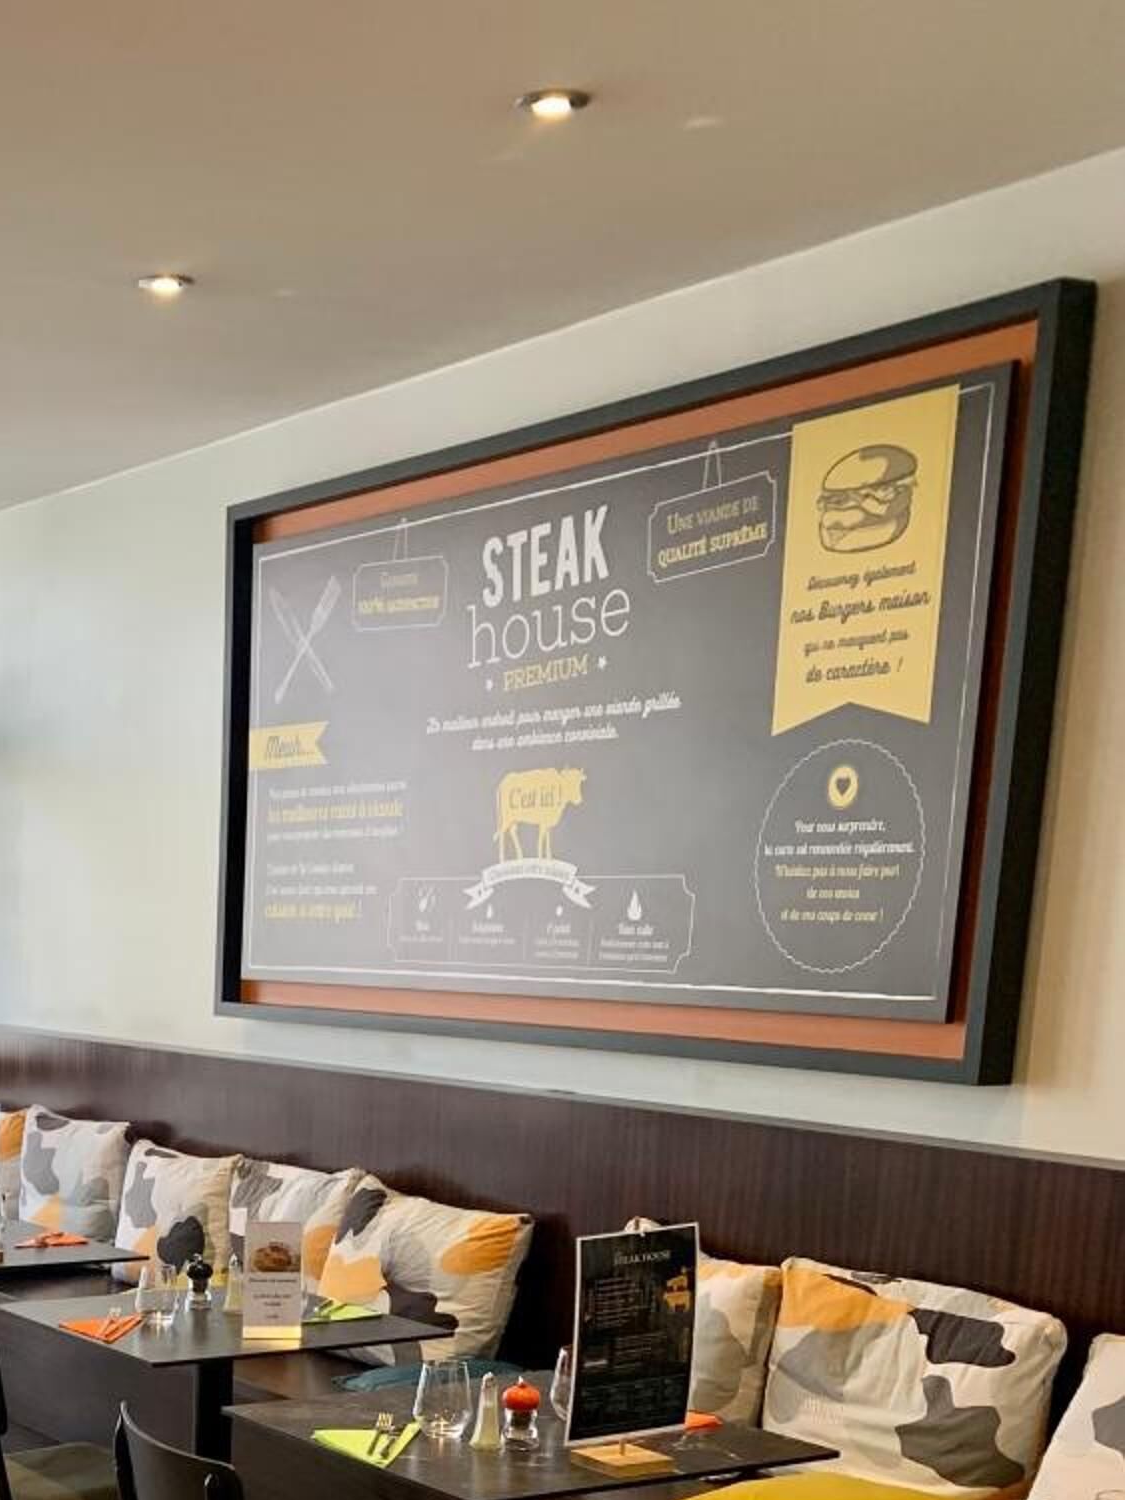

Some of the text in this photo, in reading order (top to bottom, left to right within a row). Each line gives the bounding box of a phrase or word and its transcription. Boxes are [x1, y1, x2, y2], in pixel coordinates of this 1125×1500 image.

[482, 504, 610, 608] STEAK
[467, 588, 630, 669] house
[818, 600, 876, 625] Burgers
[878, 589, 931, 612] maison
[503, 653, 590, 691] PREMIUM
